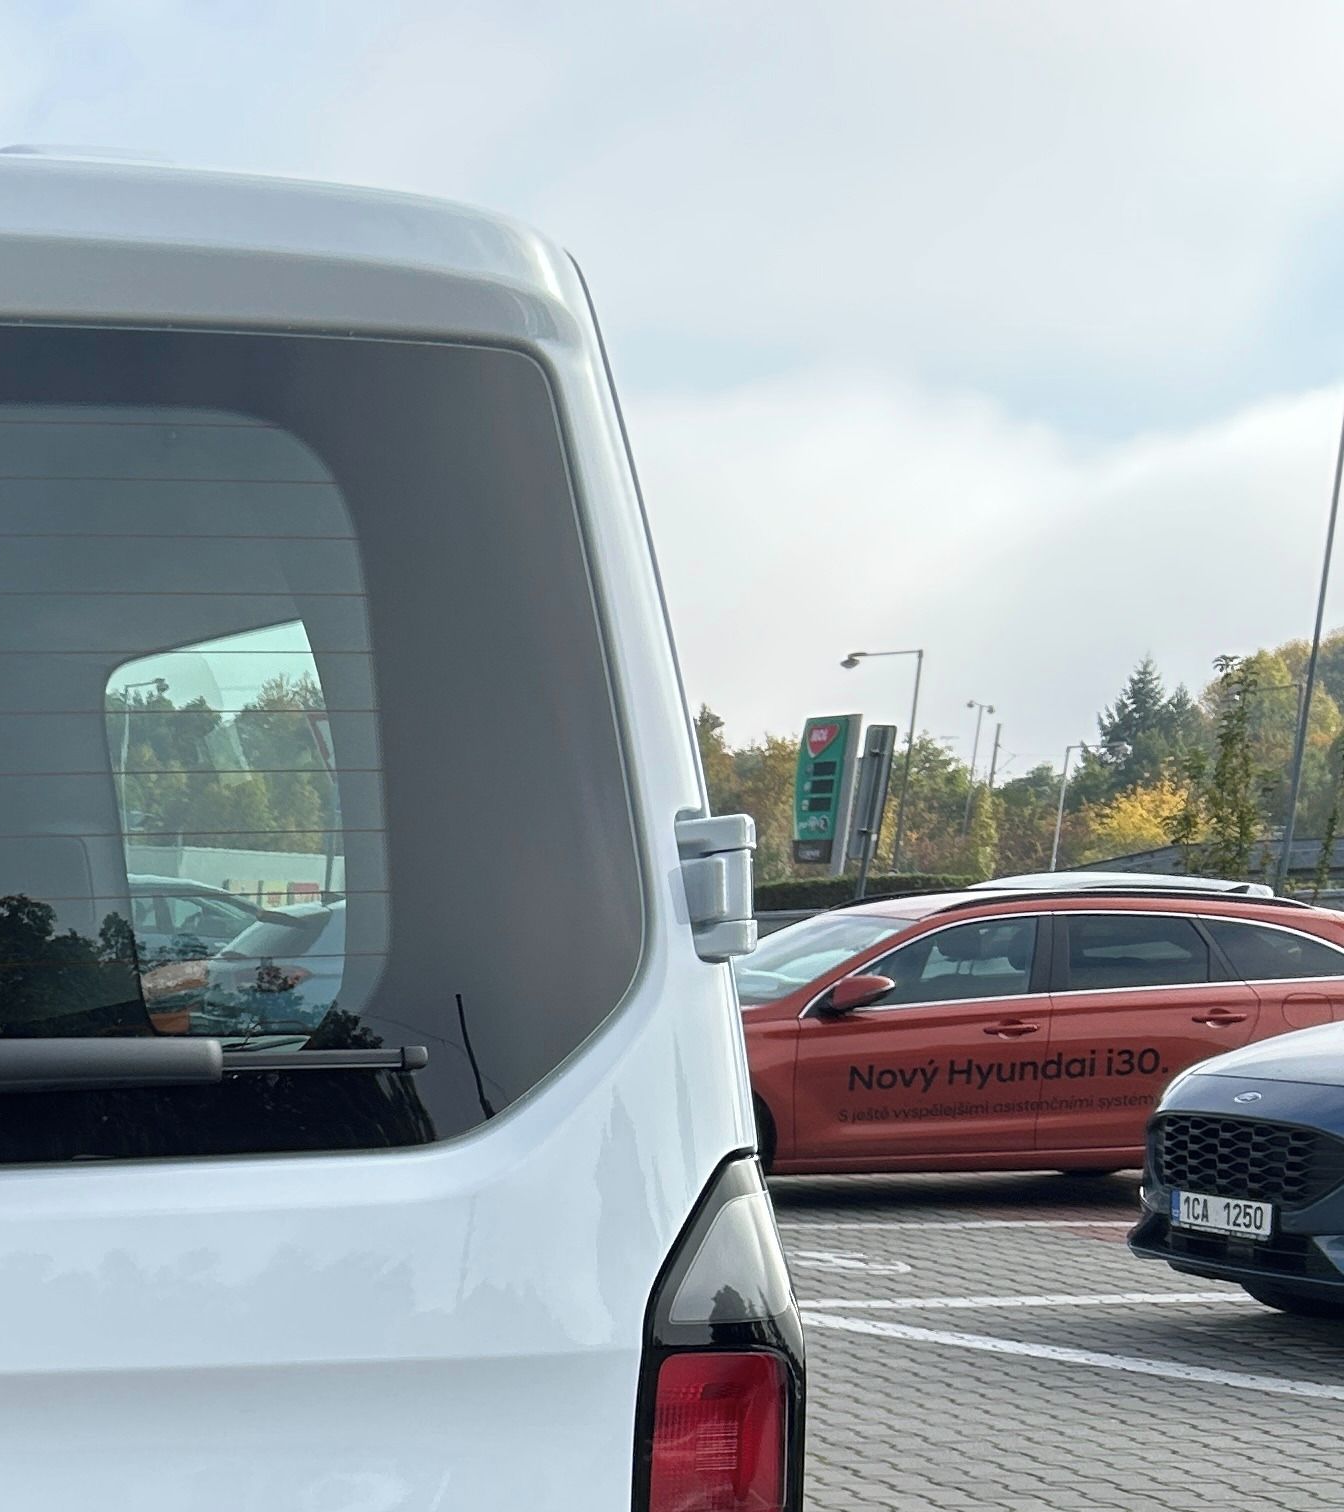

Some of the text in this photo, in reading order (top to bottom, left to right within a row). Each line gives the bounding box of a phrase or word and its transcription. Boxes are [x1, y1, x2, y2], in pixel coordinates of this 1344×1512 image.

[848, 1047, 1169, 1093] Nový Hyundai i30.
[1184, 1196, 1264, 1230] 1CA 1250
